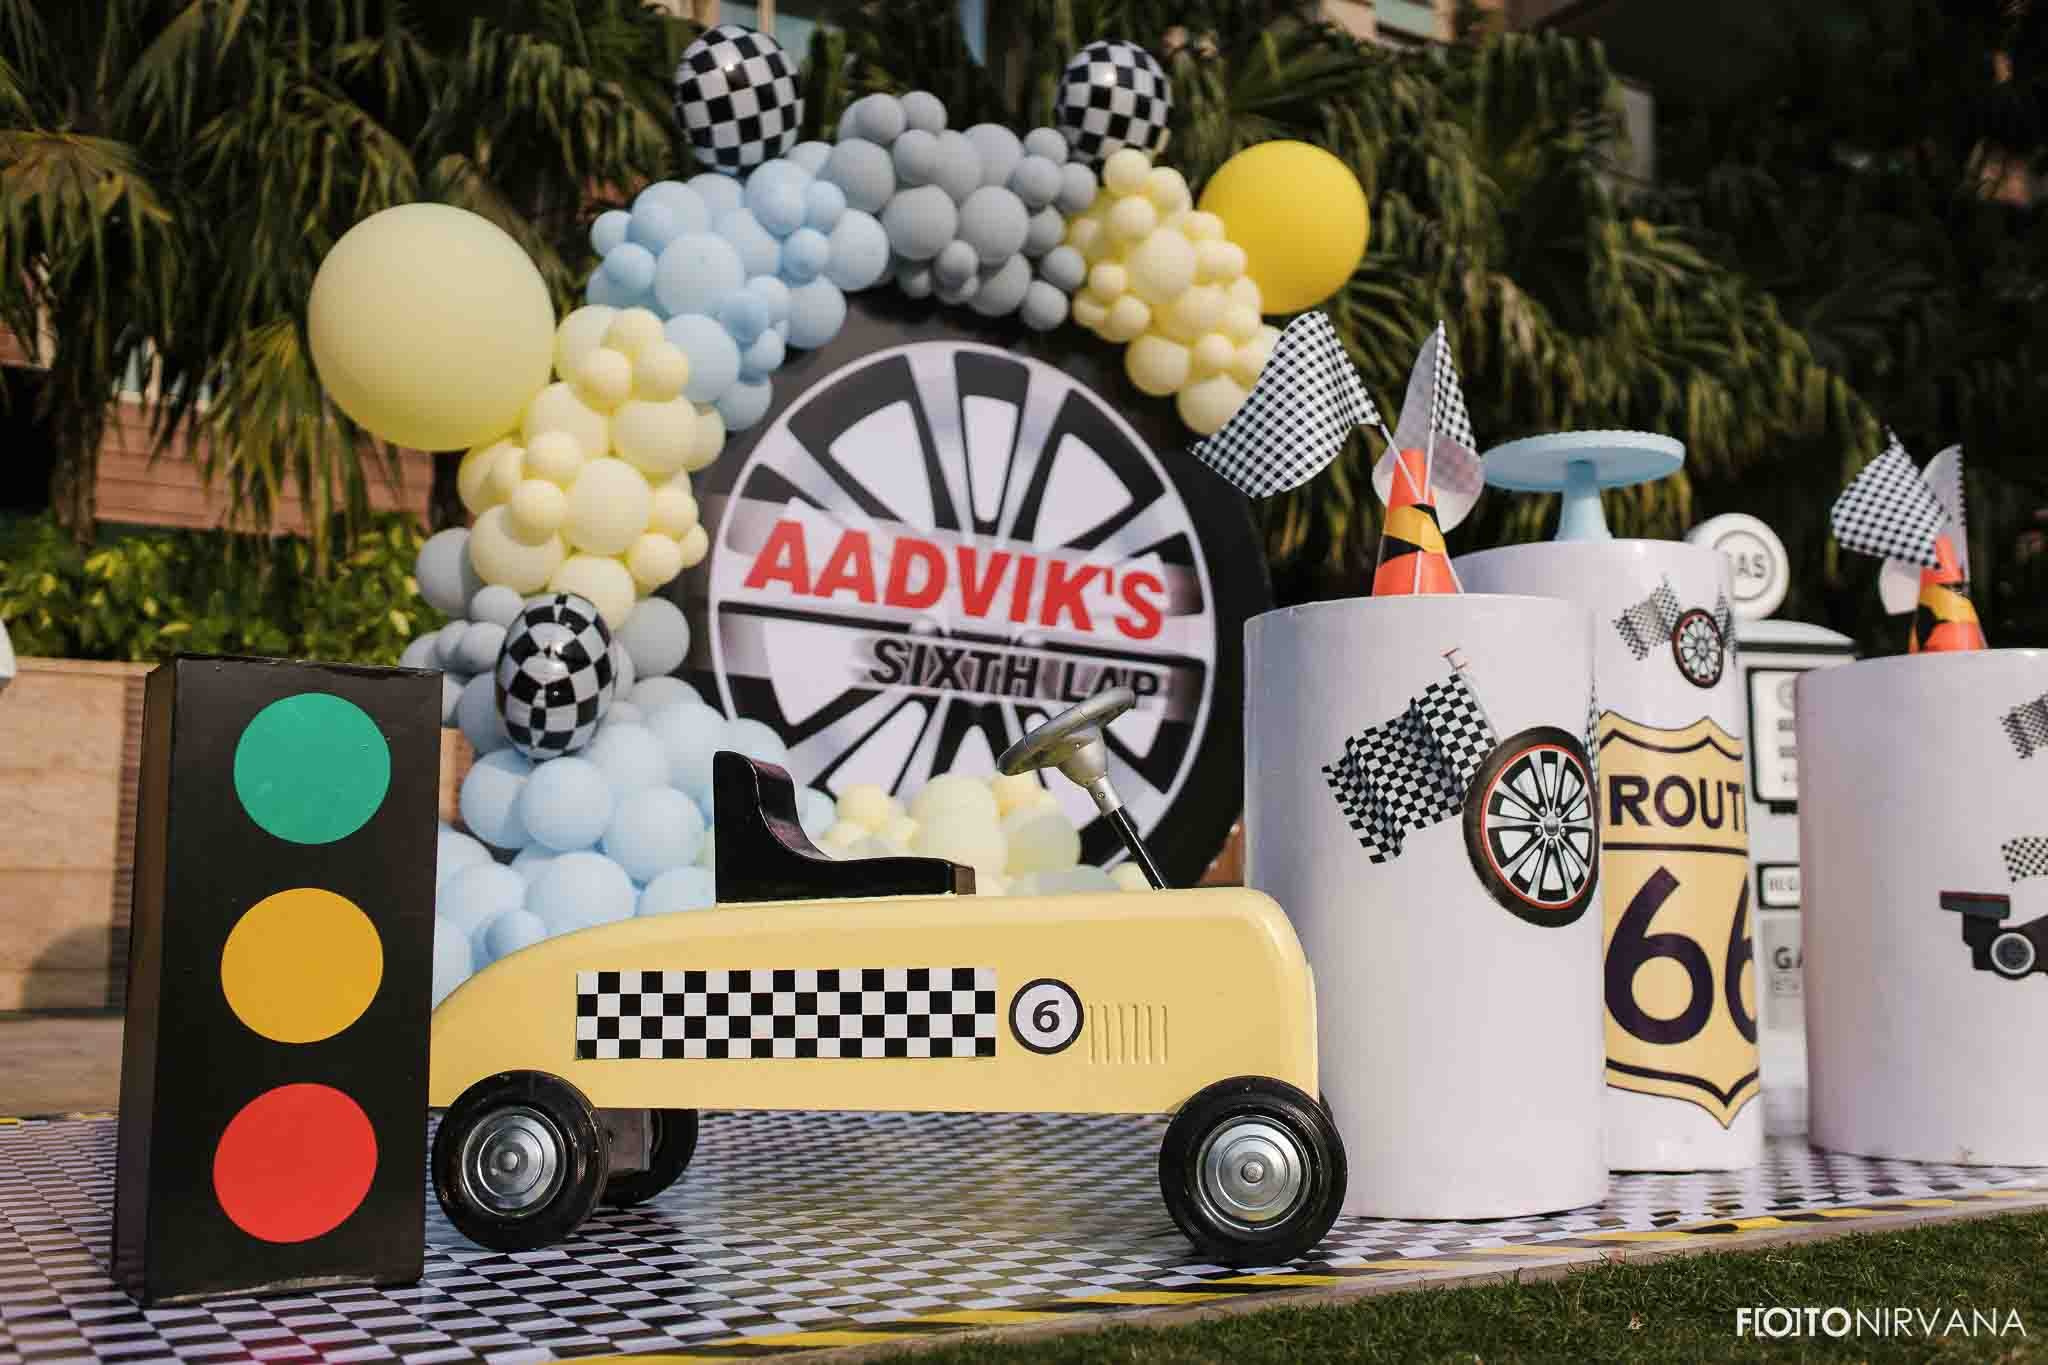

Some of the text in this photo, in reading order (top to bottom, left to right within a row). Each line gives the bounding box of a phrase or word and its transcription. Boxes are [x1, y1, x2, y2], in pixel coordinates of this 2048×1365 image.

[744, 520, 1164, 640] AADVIK'S
[1727, 553, 1766, 578] AS
[870, 639, 1159, 702] SIXTH LAP
[1608, 775, 1747, 832] ROUT
[1033, 1000, 1060, 1033] 6
